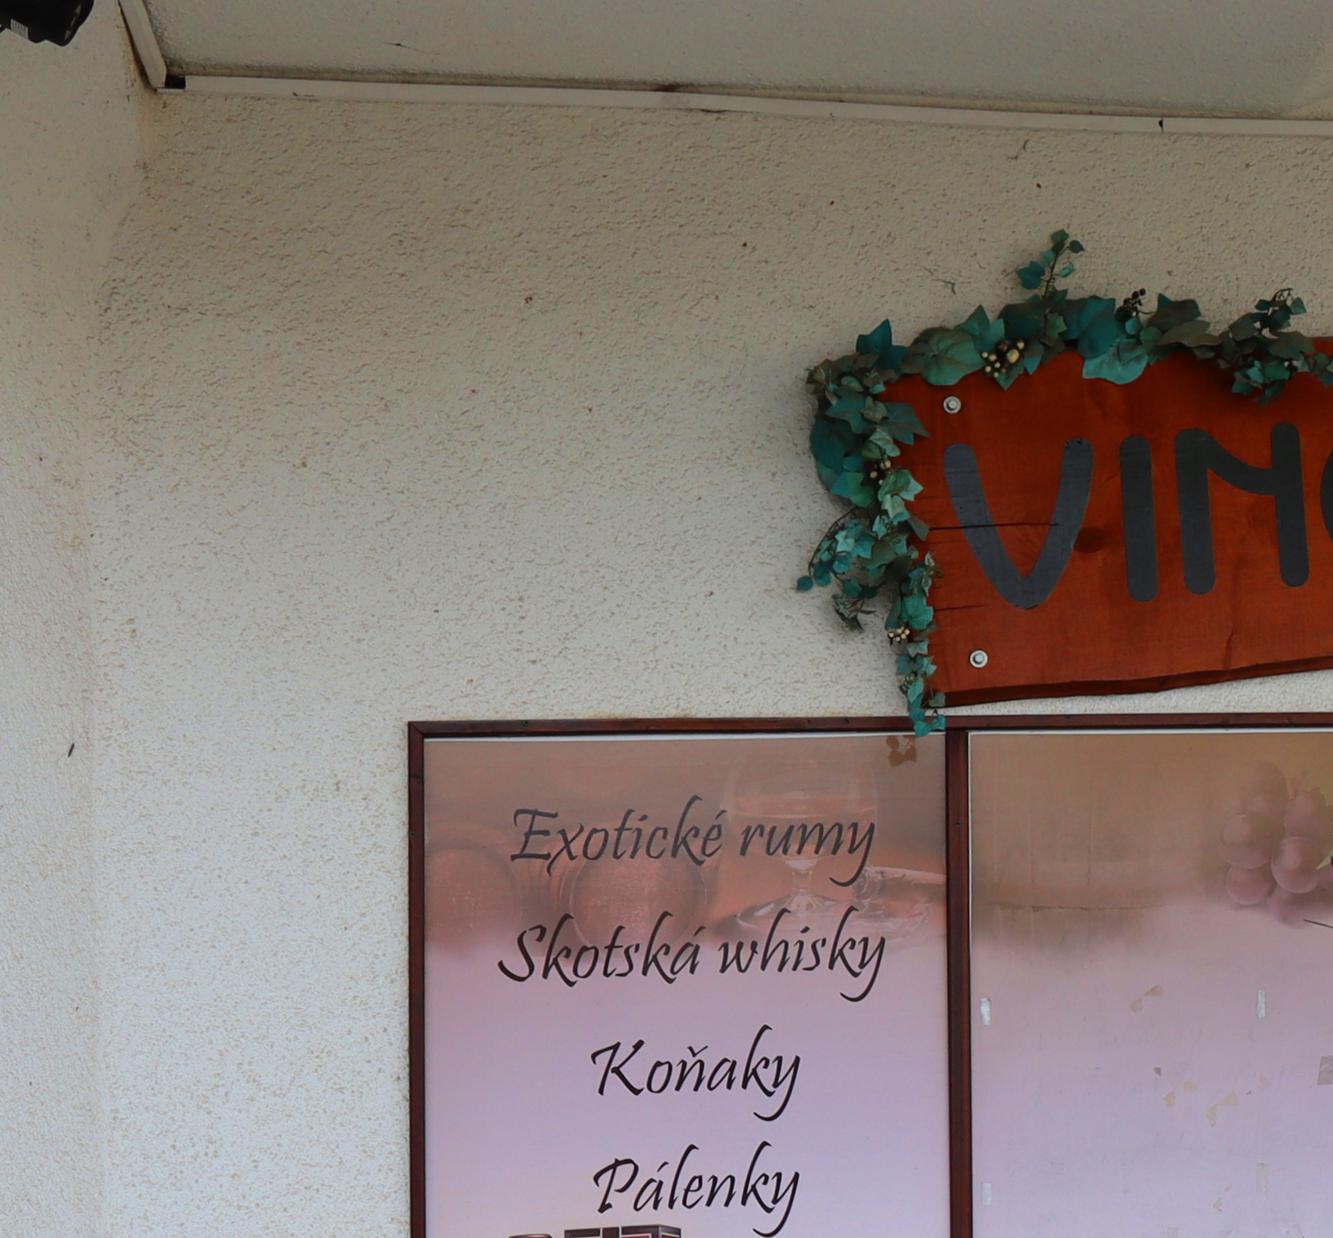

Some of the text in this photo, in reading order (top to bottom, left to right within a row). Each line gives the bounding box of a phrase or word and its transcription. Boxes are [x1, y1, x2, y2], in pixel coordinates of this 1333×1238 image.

[511, 795, 875, 887] Exotické rumy
[498, 906, 886, 1002] Skotská whisky
[590, 1024, 801, 1122] Koňaky
[592, 1140, 801, 1238] Pálenky
